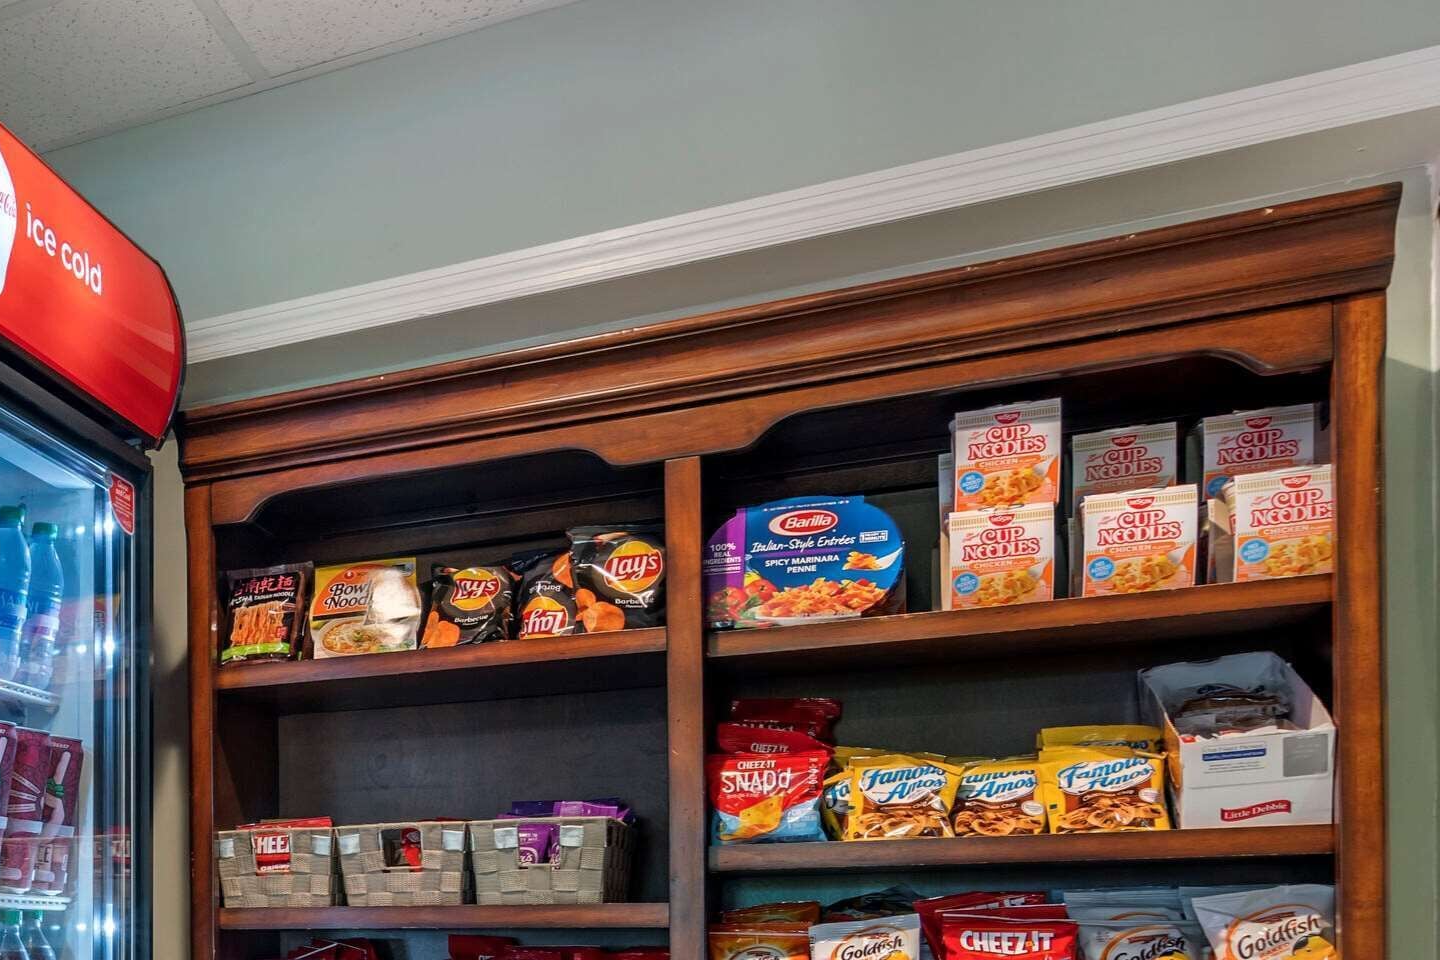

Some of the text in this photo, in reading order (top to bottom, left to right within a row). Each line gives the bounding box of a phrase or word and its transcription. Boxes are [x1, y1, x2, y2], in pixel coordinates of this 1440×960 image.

[25, 201, 102, 295] ice cold
[986, 424, 1030, 442] CUP
[1236, 429, 1283, 448] CUP
[968, 436, 1045, 460] NOODLES
[1103, 447, 1147, 465] CUP
[1217, 440, 1300, 466] NOODLES
[1086, 455, 1163, 481] NOODLES
[1271, 489, 1323, 509] CUP
[784, 515, 832, 530] Barilla
[1117, 510, 1166, 529] CUP
[980, 527, 1024, 544] CUP
[1097, 521, 1182, 546] NOODLES
[710, 543, 736, 552] 100%
[750, 535, 856, 553] Italian-Style Entrées
[962, 538, 1040, 561] NOODLES
[610, 552, 659, 580] Lay's
[765, 554, 839, 567] SPICY MARINARA
[787, 565, 817, 573] PENNE
[324, 595, 368, 610] Nood
[454, 614, 489, 624] Barbecue
[737, 760, 777, 770] CHEEZ-IT
[1058, 757, 1148, 789] Famous
[968, 776, 1038, 799] Amos
[1079, 767, 1151, 793] Amos
[877, 779, 944, 803] Amos
[1223, 802, 1288, 820] Little Debbie
[960, 930, 1054, 955] CHEEZ-IT
[1238, 914, 1322, 960] Goldfish
